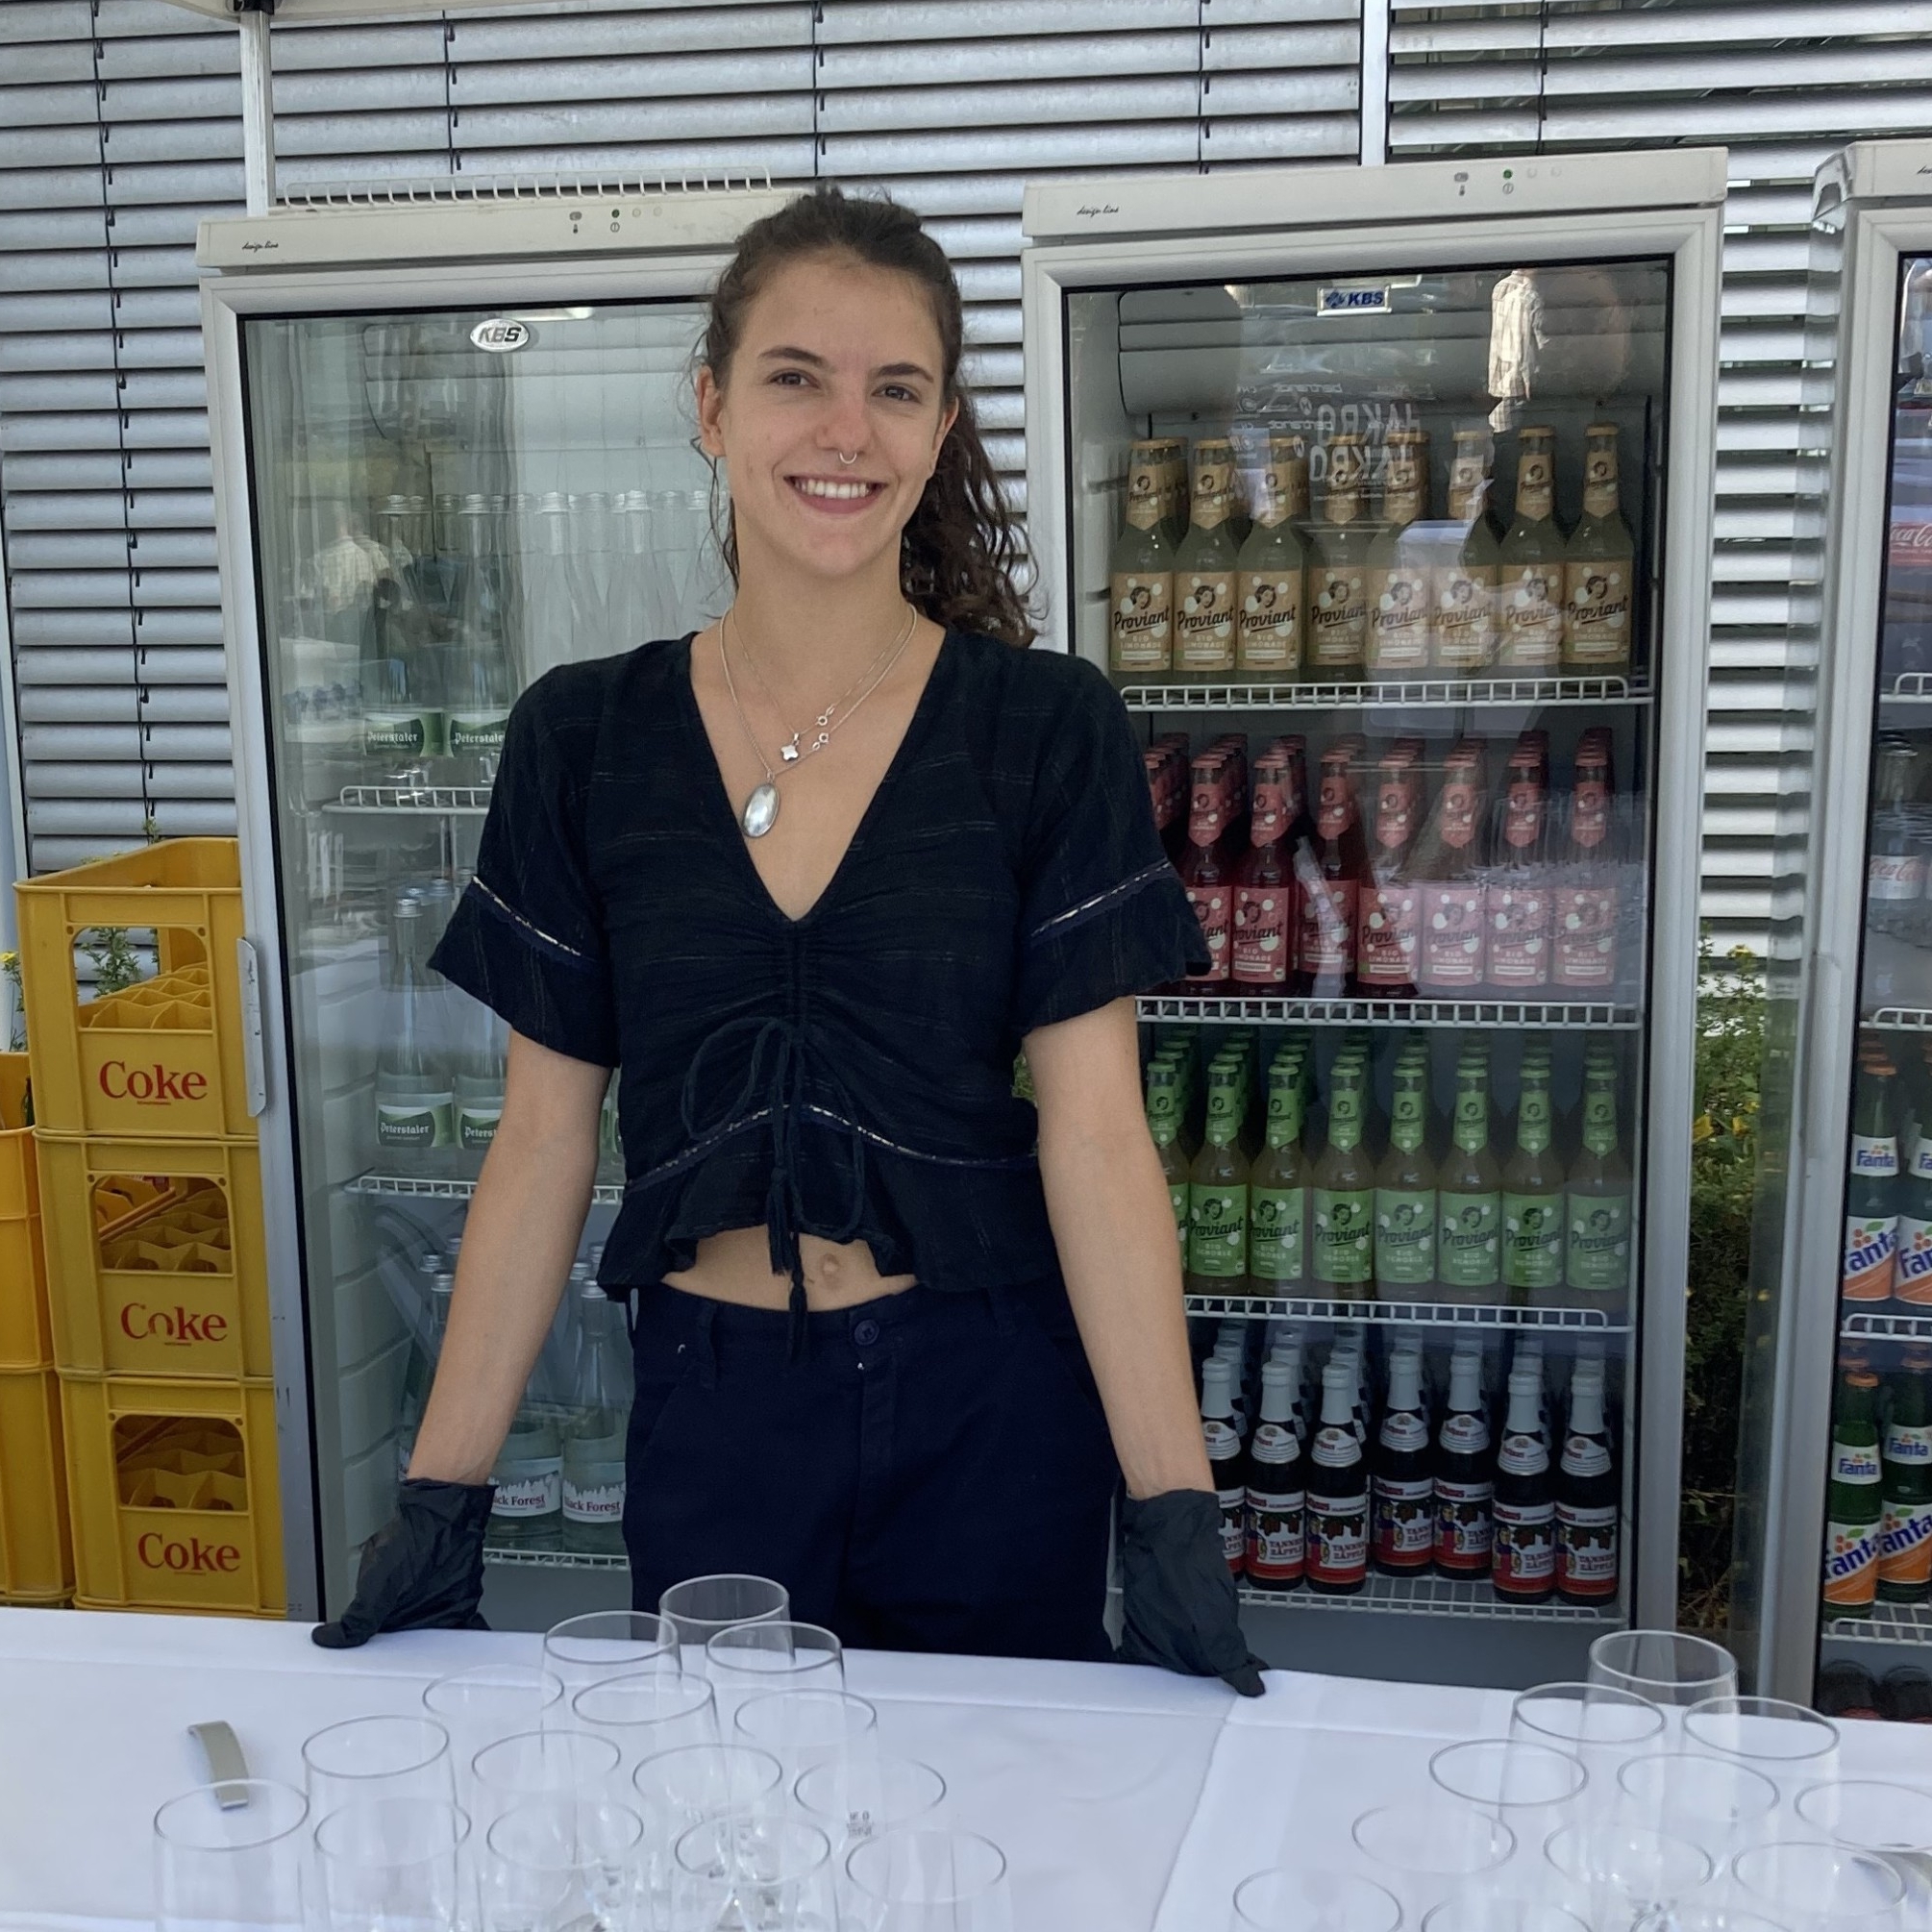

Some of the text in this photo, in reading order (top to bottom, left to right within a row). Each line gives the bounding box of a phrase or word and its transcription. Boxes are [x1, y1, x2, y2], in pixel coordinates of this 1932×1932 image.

[1348, 291, 1384, 307] KBS
[477, 326, 522, 343] KBS
[1114, 606, 1170, 631] Proviant
[1239, 605, 1296, 629] Proviant
[1312, 601, 1367, 626] Proviant
[1568, 595, 1628, 621] Proviant
[1177, 607, 1234, 631] Proviant
[367, 731, 418, 746] Peterstaler
[99, 1061, 208, 1101] Coke
[381, 1122, 430, 1134] Peterstaler
[464, 1126, 497, 1138] Peterst
[1856, 1150, 1895, 1167] Fanta
[1315, 1221, 1370, 1242] Proviant
[1376, 1223, 1433, 1244] Proviant
[1442, 1224, 1499, 1246] Proviant
[1505, 1226, 1563, 1247] Proviant
[1845, 1228, 1899, 1276] anta
[121, 1302, 228, 1342] Coke
[1888, 1437, 1928, 1456] Fanta
[1838, 1458, 1877, 1475] Fanta
[510, 1494, 545, 1506] Forest
[586, 1501, 621, 1512] Forest
[138, 1532, 241, 1573] Coke
